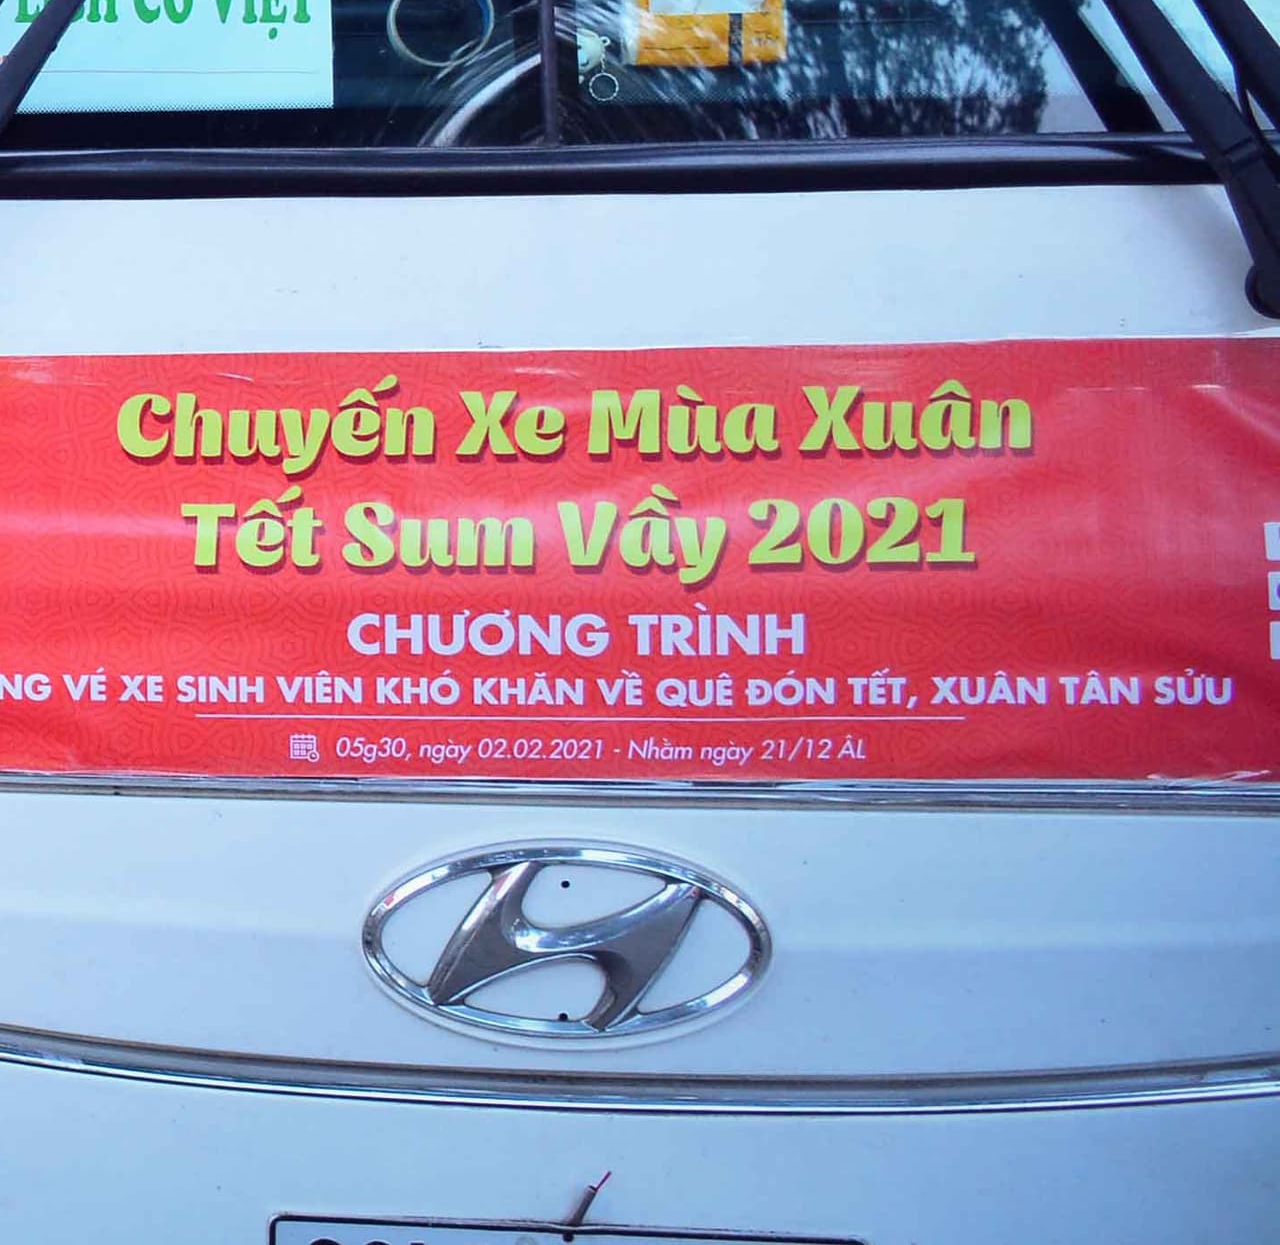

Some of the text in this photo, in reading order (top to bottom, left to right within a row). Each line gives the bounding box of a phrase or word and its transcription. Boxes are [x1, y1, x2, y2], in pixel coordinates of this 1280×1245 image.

[117, 374, 1033, 476] Chuyến Xe Mùa Xuân
[181, 483, 976, 585] Tết Sum Vầy 2021
[347, 602, 806, 656] CHƯƠNG TRÌNH
[62, 666, 108, 702] VÉ
[119, 674, 164, 703] XE
[176, 675, 266, 704] SINH
[276, 669, 364, 704] VIÊN
[376, 669, 460, 706] KHÓ
[473, 671, 586, 706] KHĂN
[597, 668, 643, 706] VỀ
[655, 672, 733, 706] QUÊ
[745, 670, 836, 706] ĐÓN
[847, 667, 918, 709] TẾT,
[931, 669, 1047, 705] XUÂN
[1059, 669, 1138, 705] TÂN
[1153, 668, 1233, 706] SỬU
[335, 737, 412, 763] 05g30,
[419, 737, 472, 764] ngày
[477, 738, 603, 761] 02.02.2021
[628, 737, 693, 761] Nhằm
[700, 739, 754, 766] ngày
[761, 738, 832, 762] 21/12
[838, 734, 867, 759] ÂL
